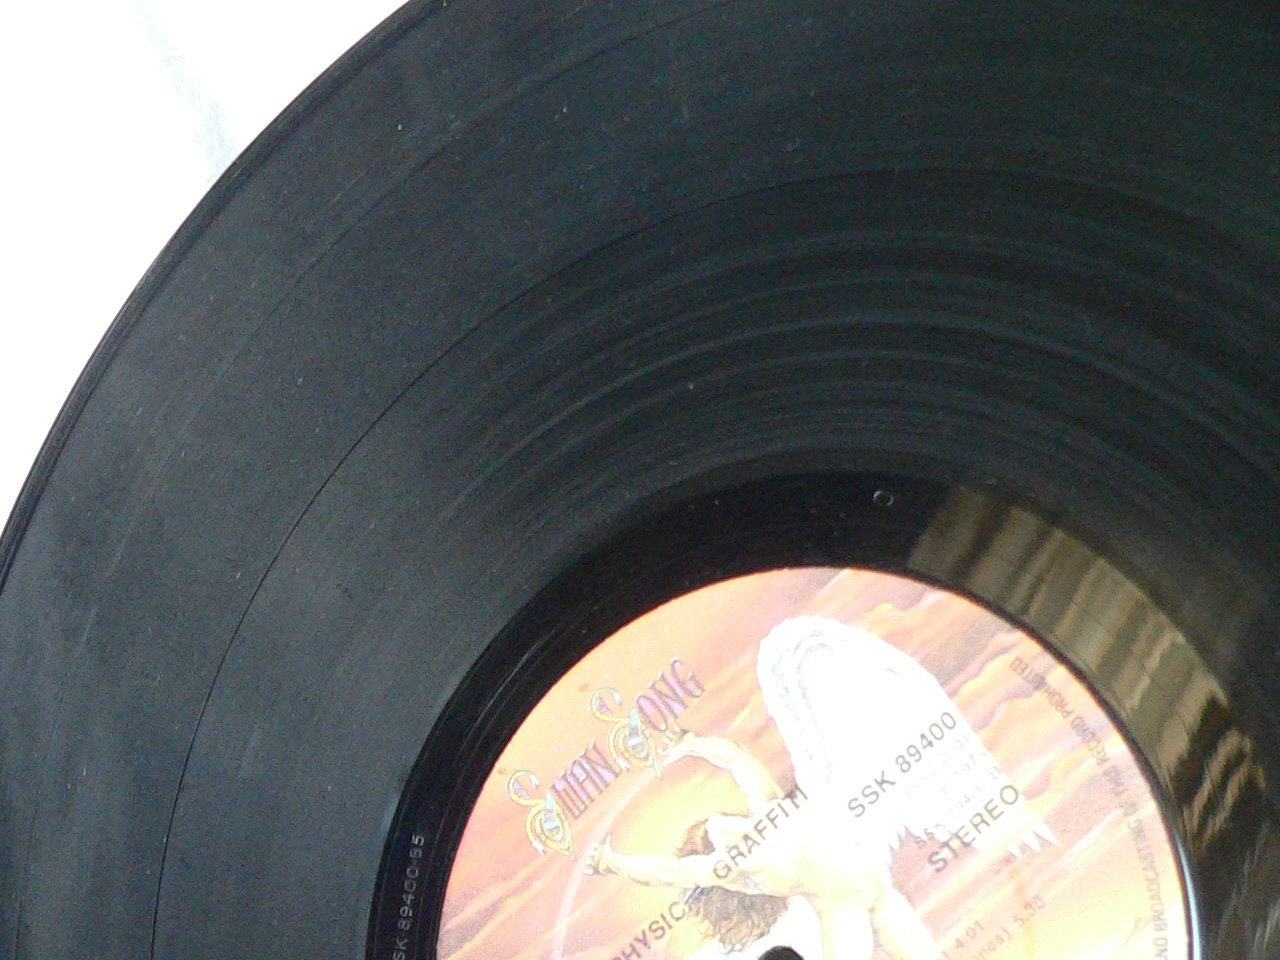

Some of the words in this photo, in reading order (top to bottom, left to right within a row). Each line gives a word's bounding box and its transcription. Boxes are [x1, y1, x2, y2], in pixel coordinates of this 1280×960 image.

[846, 770, 895, 817] SSK
[892, 711, 958, 772] 89400
[708, 788, 811, 880] GRAFFITI
[925, 783, 1022, 872] STEREO
